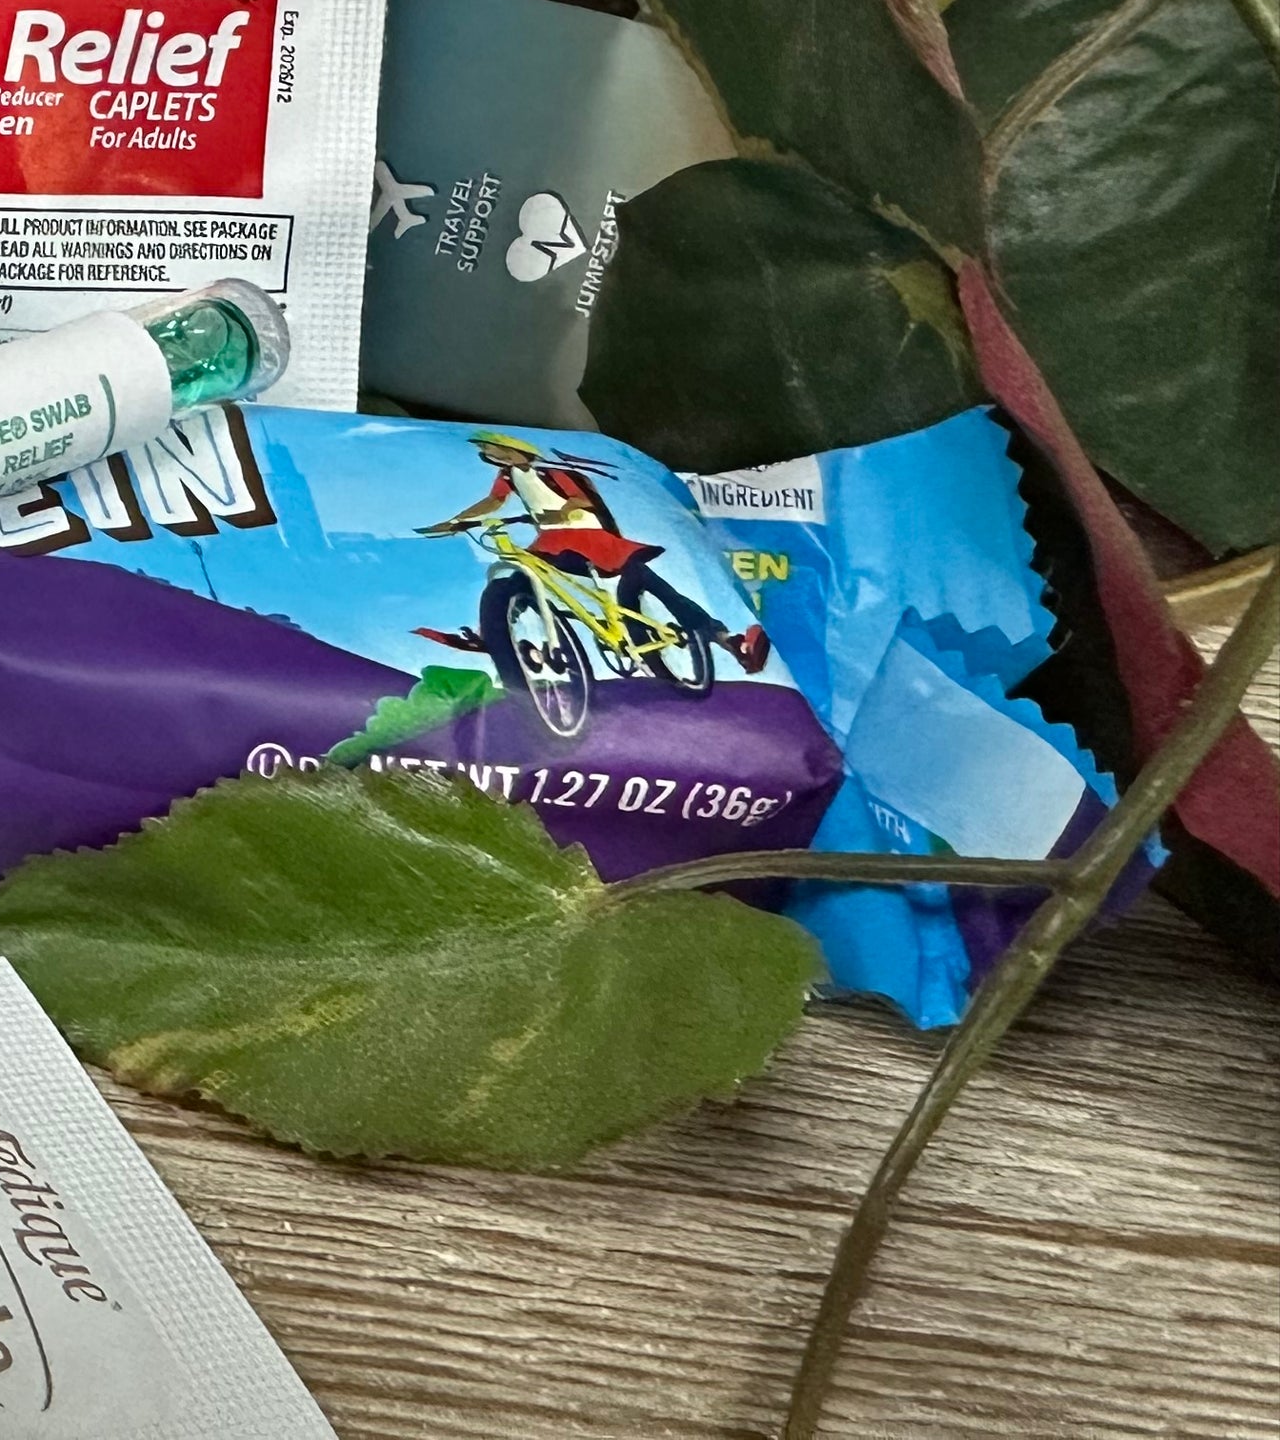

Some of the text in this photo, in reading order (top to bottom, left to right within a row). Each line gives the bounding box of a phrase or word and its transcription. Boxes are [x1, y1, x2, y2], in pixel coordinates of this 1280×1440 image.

[4, 9, 250, 89] Relief
[90, 90, 217, 122] CAPLETS
[90, 127, 197, 150] For Adults
[23, 218, 83, 237] PRODUCT
[184, 220, 208, 238] SEE
[211, 222, 278, 240] PACKAGE
[435, 178, 474, 257] TRAVEL
[456, 172, 503, 273] SUPPORT
[33, 240, 57, 258] ALL
[62, 241, 134, 259] WARNINGS
[137, 242, 165, 259] AND
[170, 242, 248, 260] DIRECTIONS
[251, 243, 272, 261] ON
[58, 264, 84, 281] FOR
[87, 264, 171, 282] REFERENCE.
[30, 394, 92, 433] SWAB
[3, 433, 75, 475] RELIEF
[532, 768, 608, 809] 1.27
[618, 777, 676, 814] OZ
